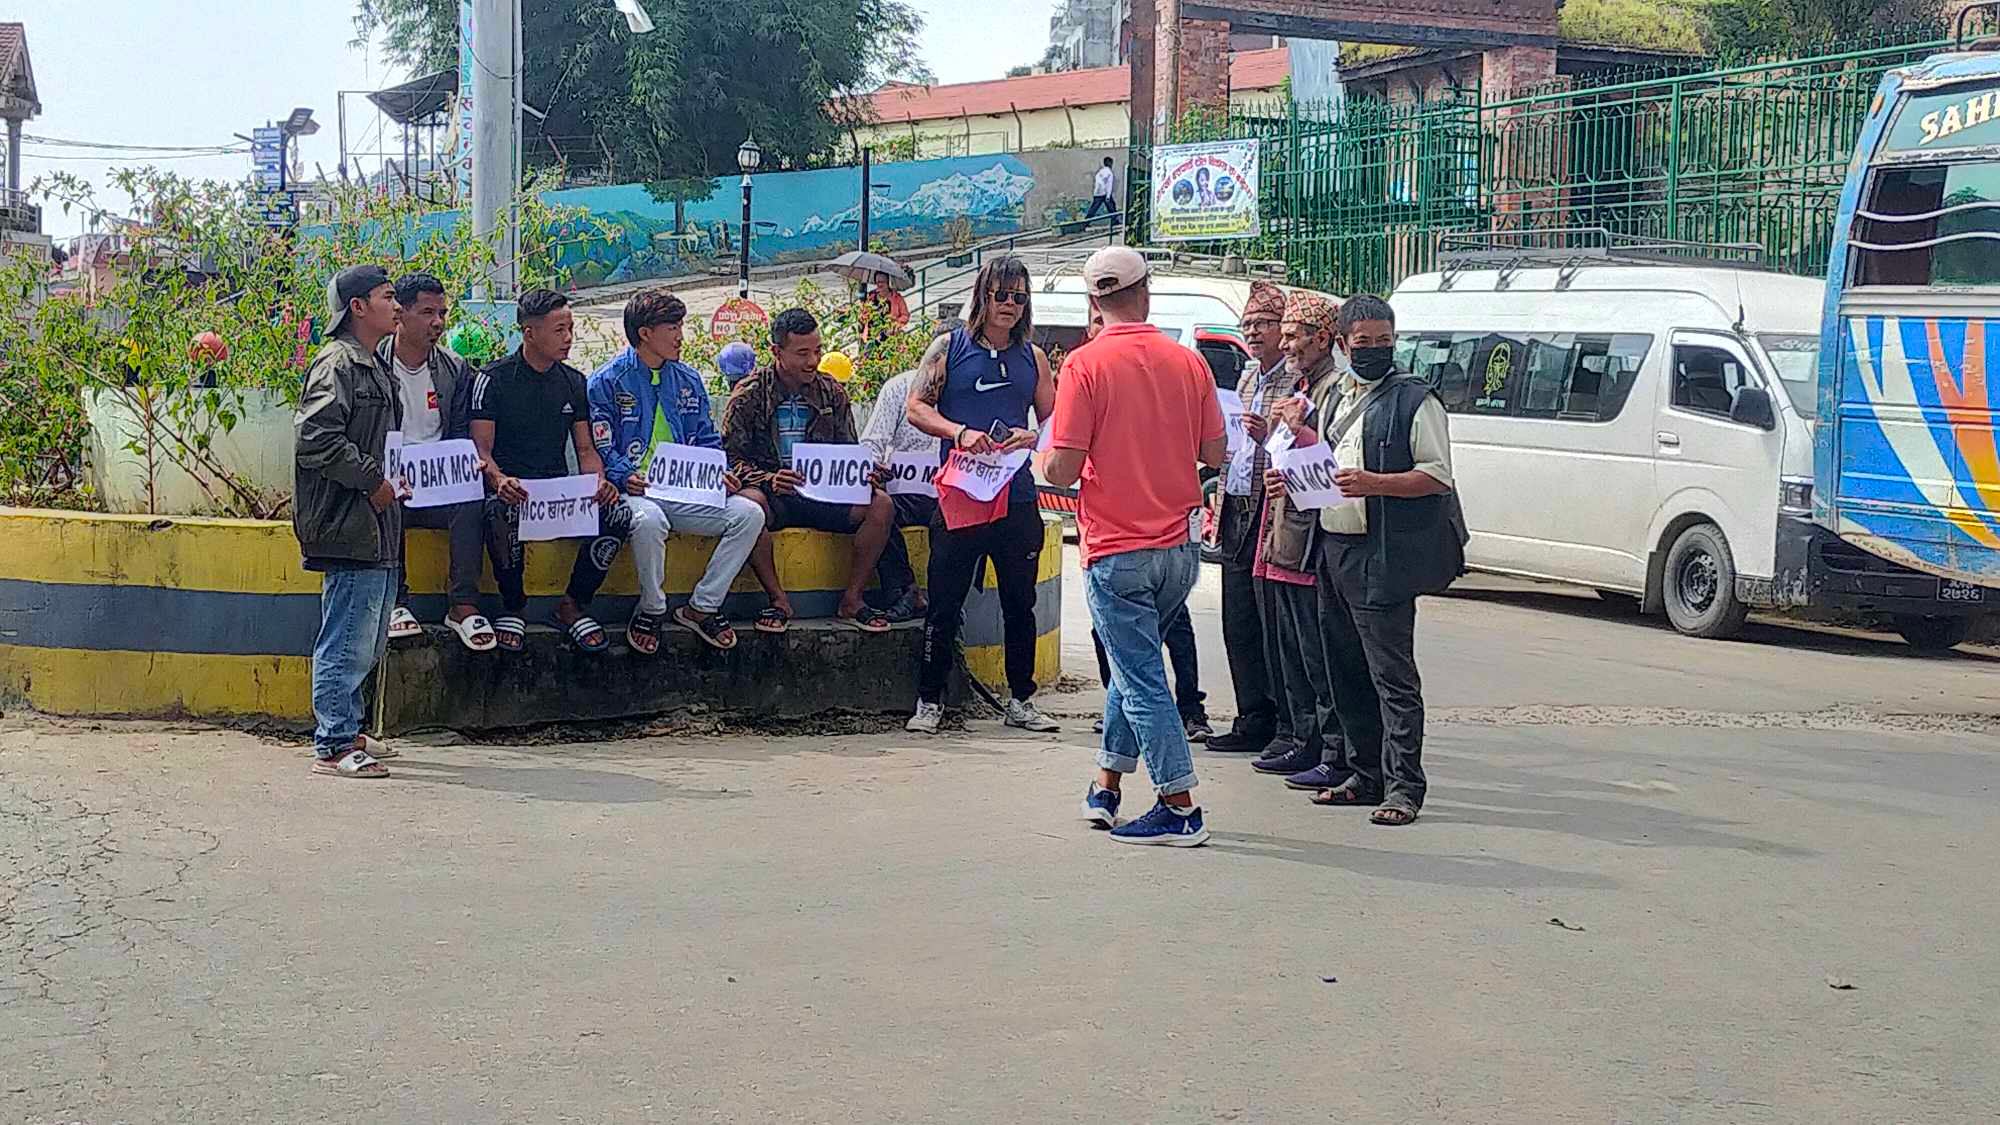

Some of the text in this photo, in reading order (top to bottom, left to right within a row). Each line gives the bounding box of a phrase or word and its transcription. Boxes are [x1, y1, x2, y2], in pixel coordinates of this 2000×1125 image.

[400, 453, 480, 488] O BAK MCC
[648, 456, 724, 490] GO BAK MCC
[796, 458, 870, 487] NO MCC
[890, 463, 916, 481] NO
[952, 453, 977, 474] MCC
[1281, 458, 1338, 494] NO MCC
[520, 499, 545, 521] MCC
